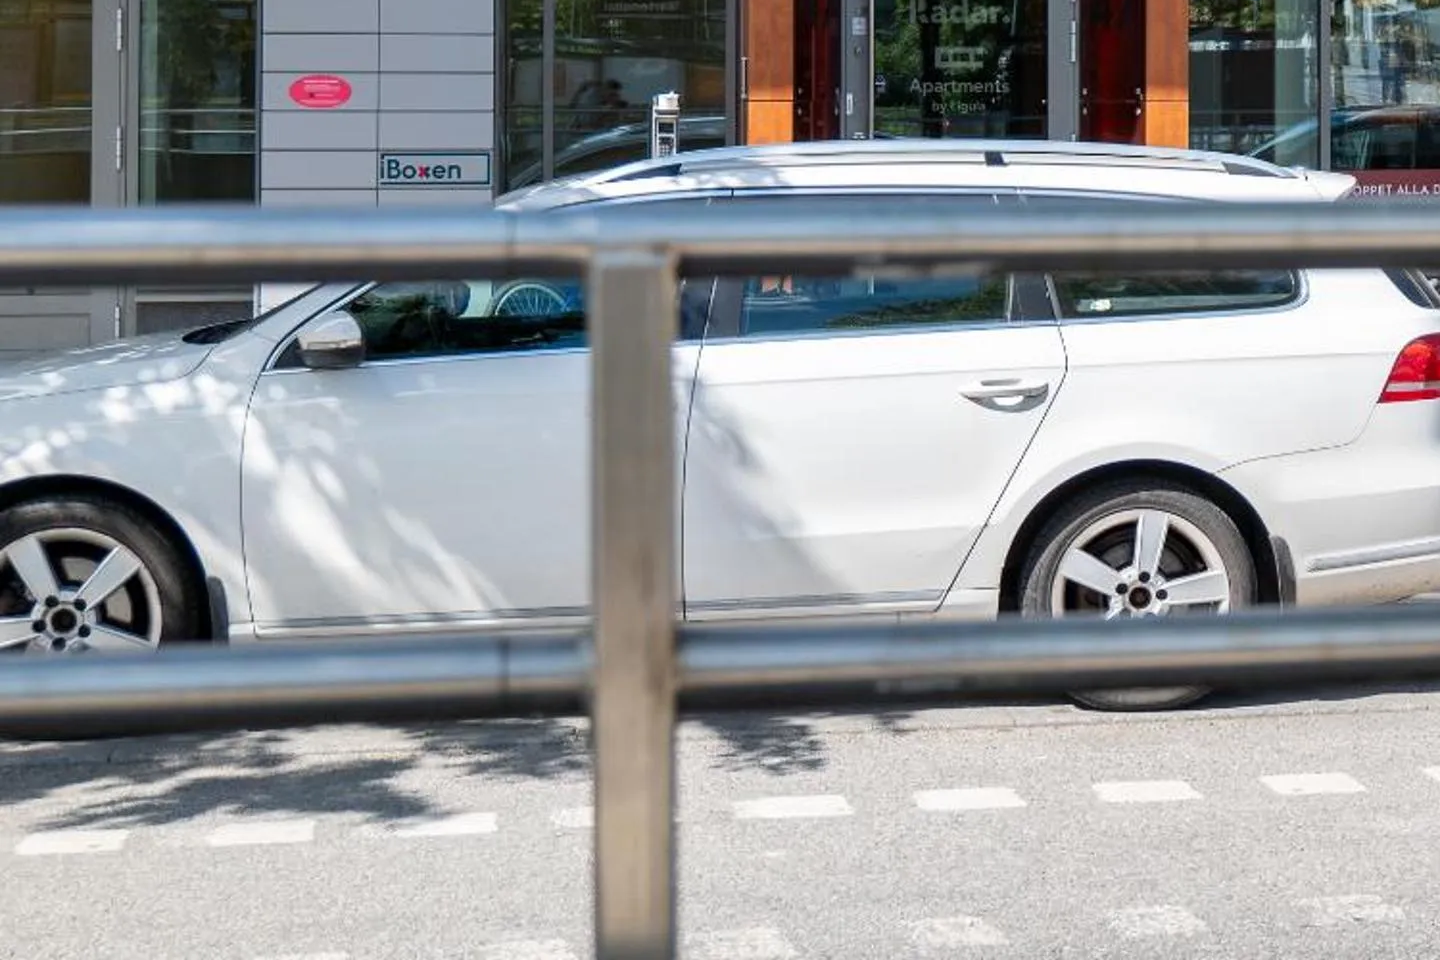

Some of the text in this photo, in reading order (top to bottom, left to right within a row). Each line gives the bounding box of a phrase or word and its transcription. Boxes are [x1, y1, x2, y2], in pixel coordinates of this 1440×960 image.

[910, 77, 1011, 96] Apartments
[380, 158, 462, 179] iBoxen
[1397, 183, 1430, 195] ALLA
